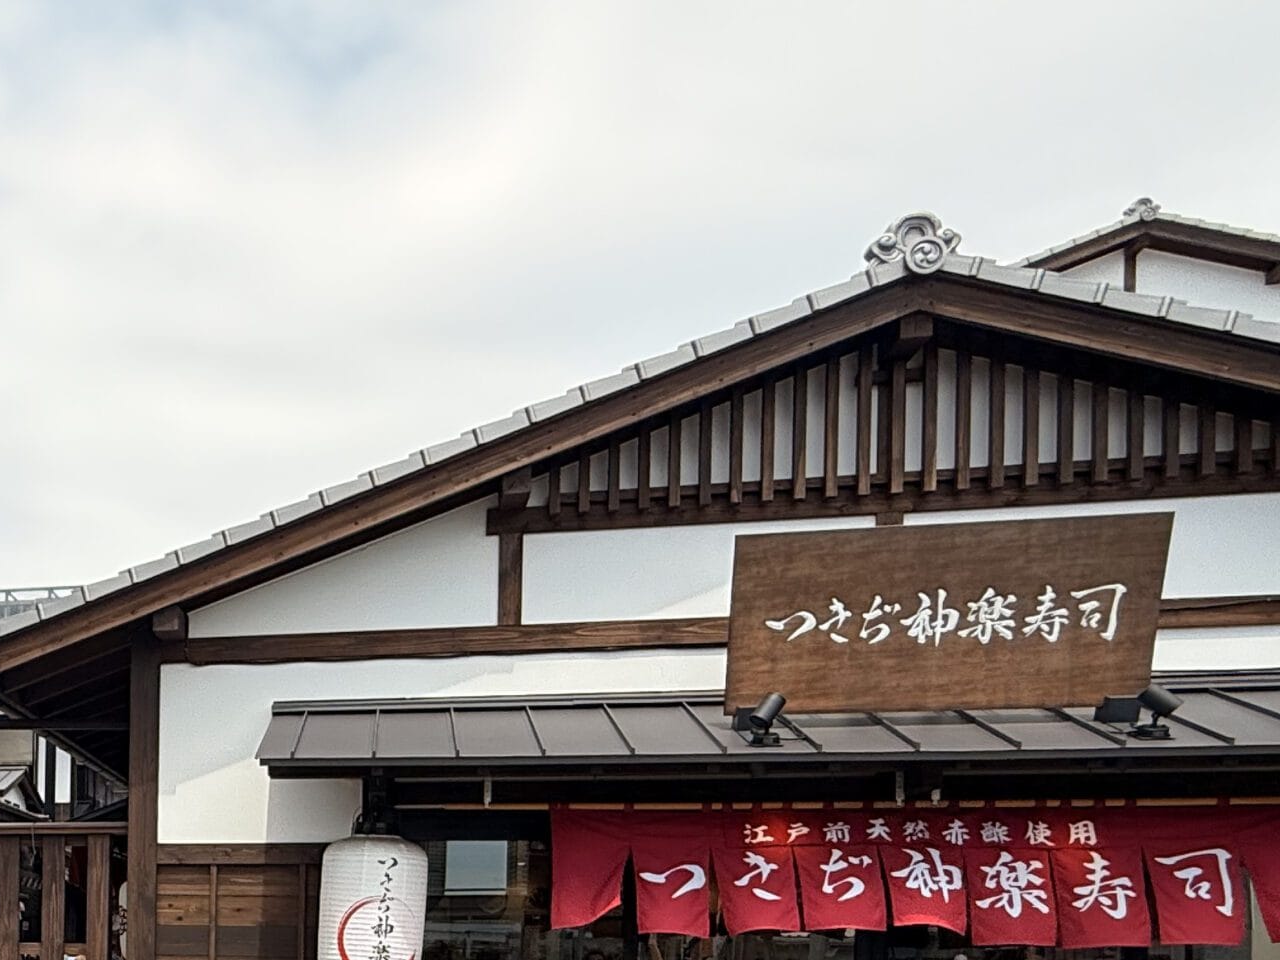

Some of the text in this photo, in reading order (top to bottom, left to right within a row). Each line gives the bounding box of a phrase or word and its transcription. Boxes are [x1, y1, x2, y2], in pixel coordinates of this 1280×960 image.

[765, 583, 1128, 647] つきぢ神楽寿司
[743, 818, 1099, 847] 江戸前天然赤酢使用
[639, 848, 1233, 920] つきぢ神楽寿司
